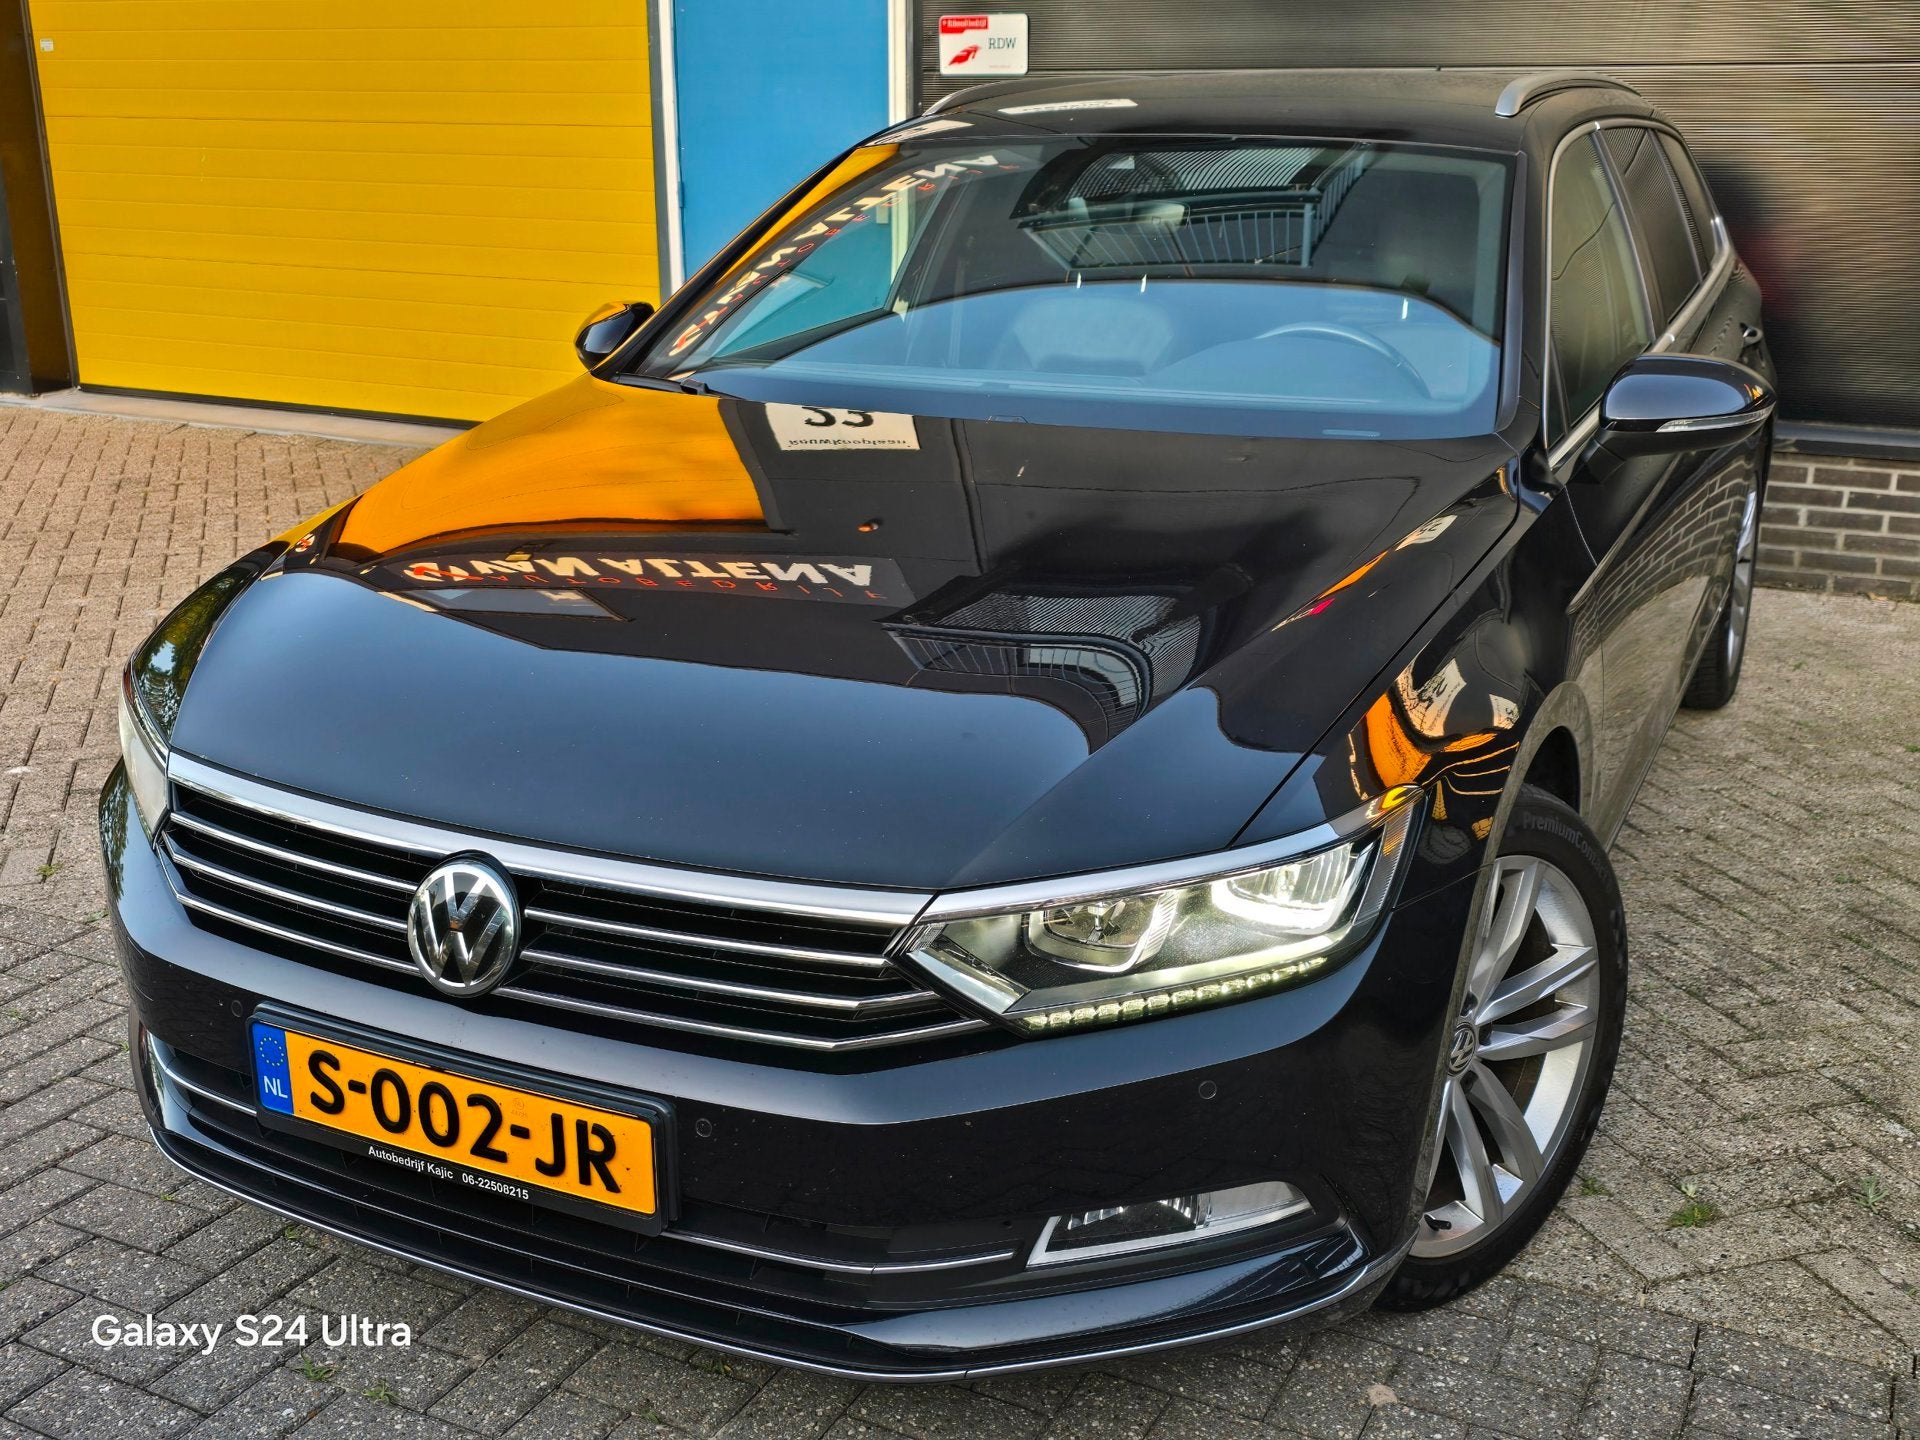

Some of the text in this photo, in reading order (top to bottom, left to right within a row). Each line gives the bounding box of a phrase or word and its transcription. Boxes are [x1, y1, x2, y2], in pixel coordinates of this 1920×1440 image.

[988, 37, 1017, 50] RDW
[263, 1075, 288, 1100] NL
[307, 1048, 622, 1194] S-002-JR
[368, 1146, 529, 1201] Autobedrijf Kajic 06-22508215
